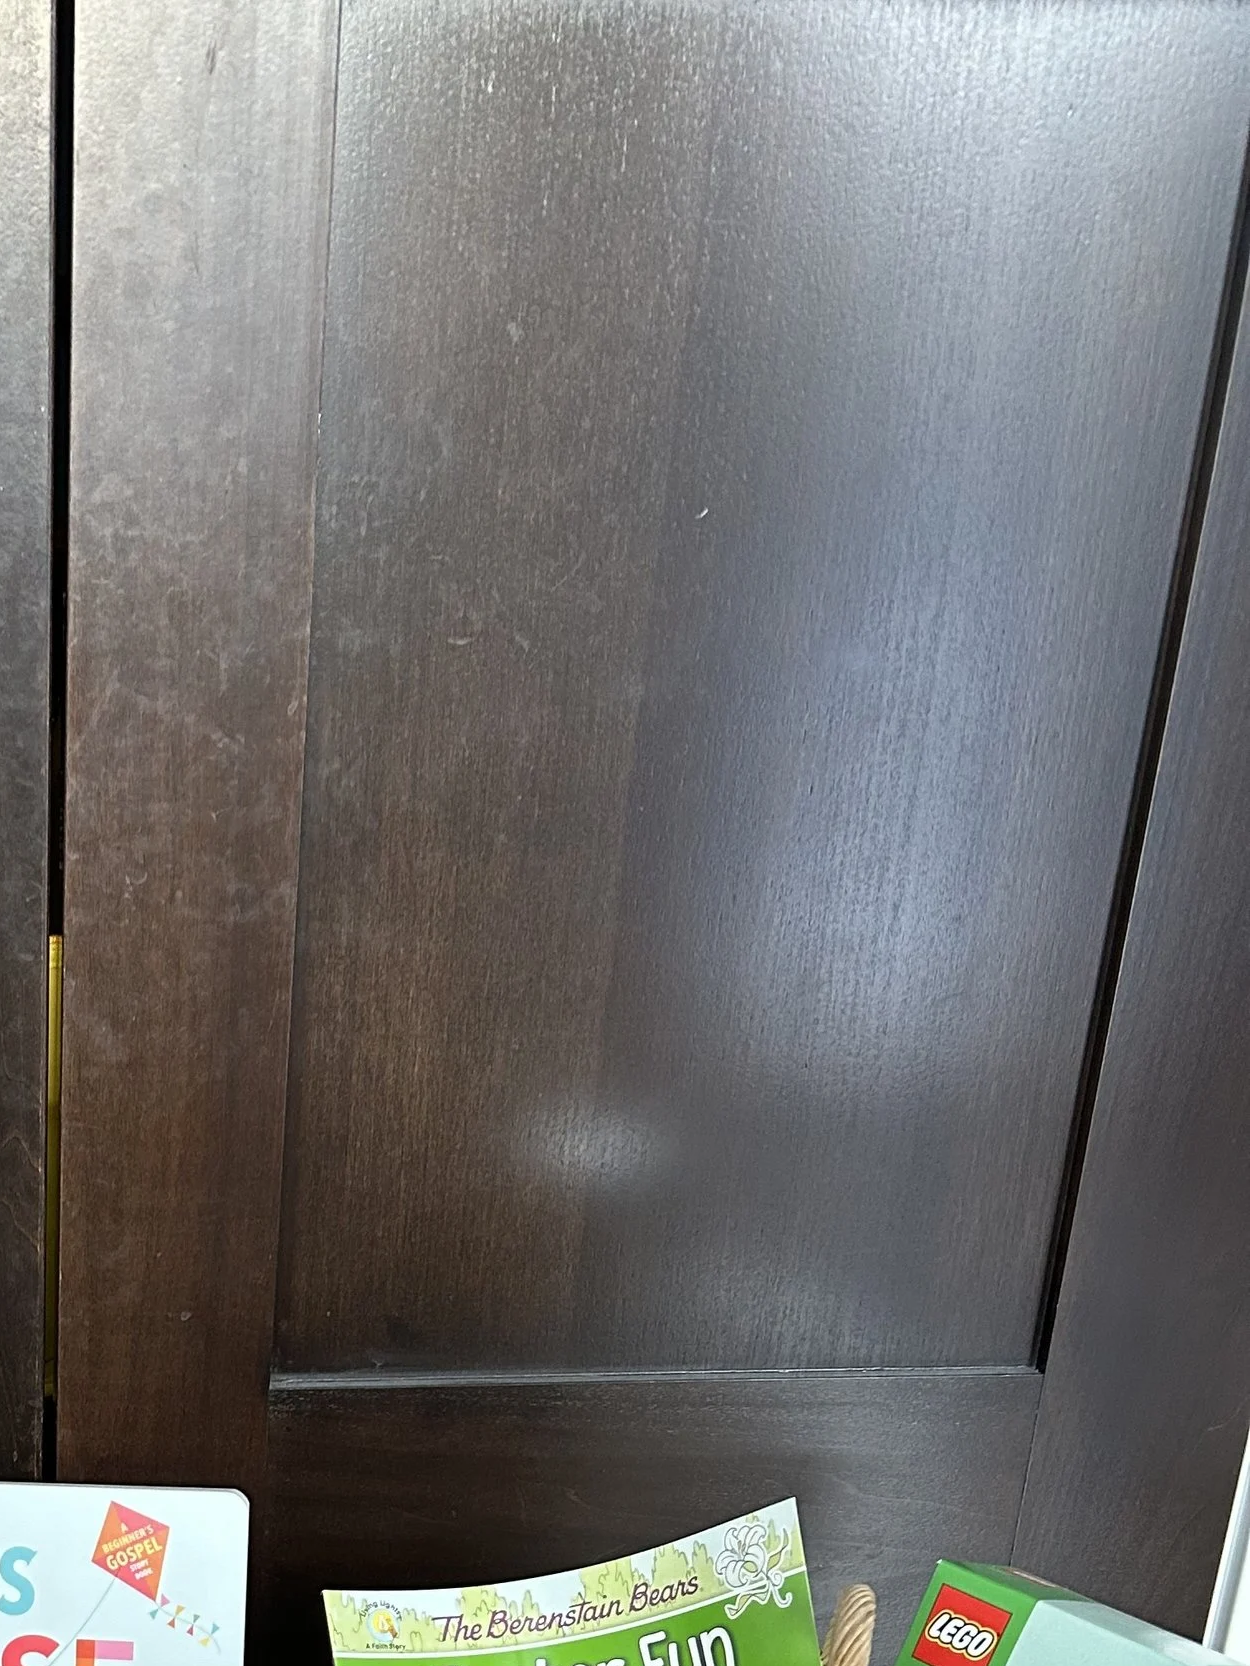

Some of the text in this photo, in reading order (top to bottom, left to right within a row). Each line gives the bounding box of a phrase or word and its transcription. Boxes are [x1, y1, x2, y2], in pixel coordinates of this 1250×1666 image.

[101, 1523, 154, 1554] BEGINNER'S
[106, 1536, 163, 1571] GOSPEL
[431, 1575, 700, 1642] The Berenstain Bears
[927, 1610, 996, 1659] LEGO
